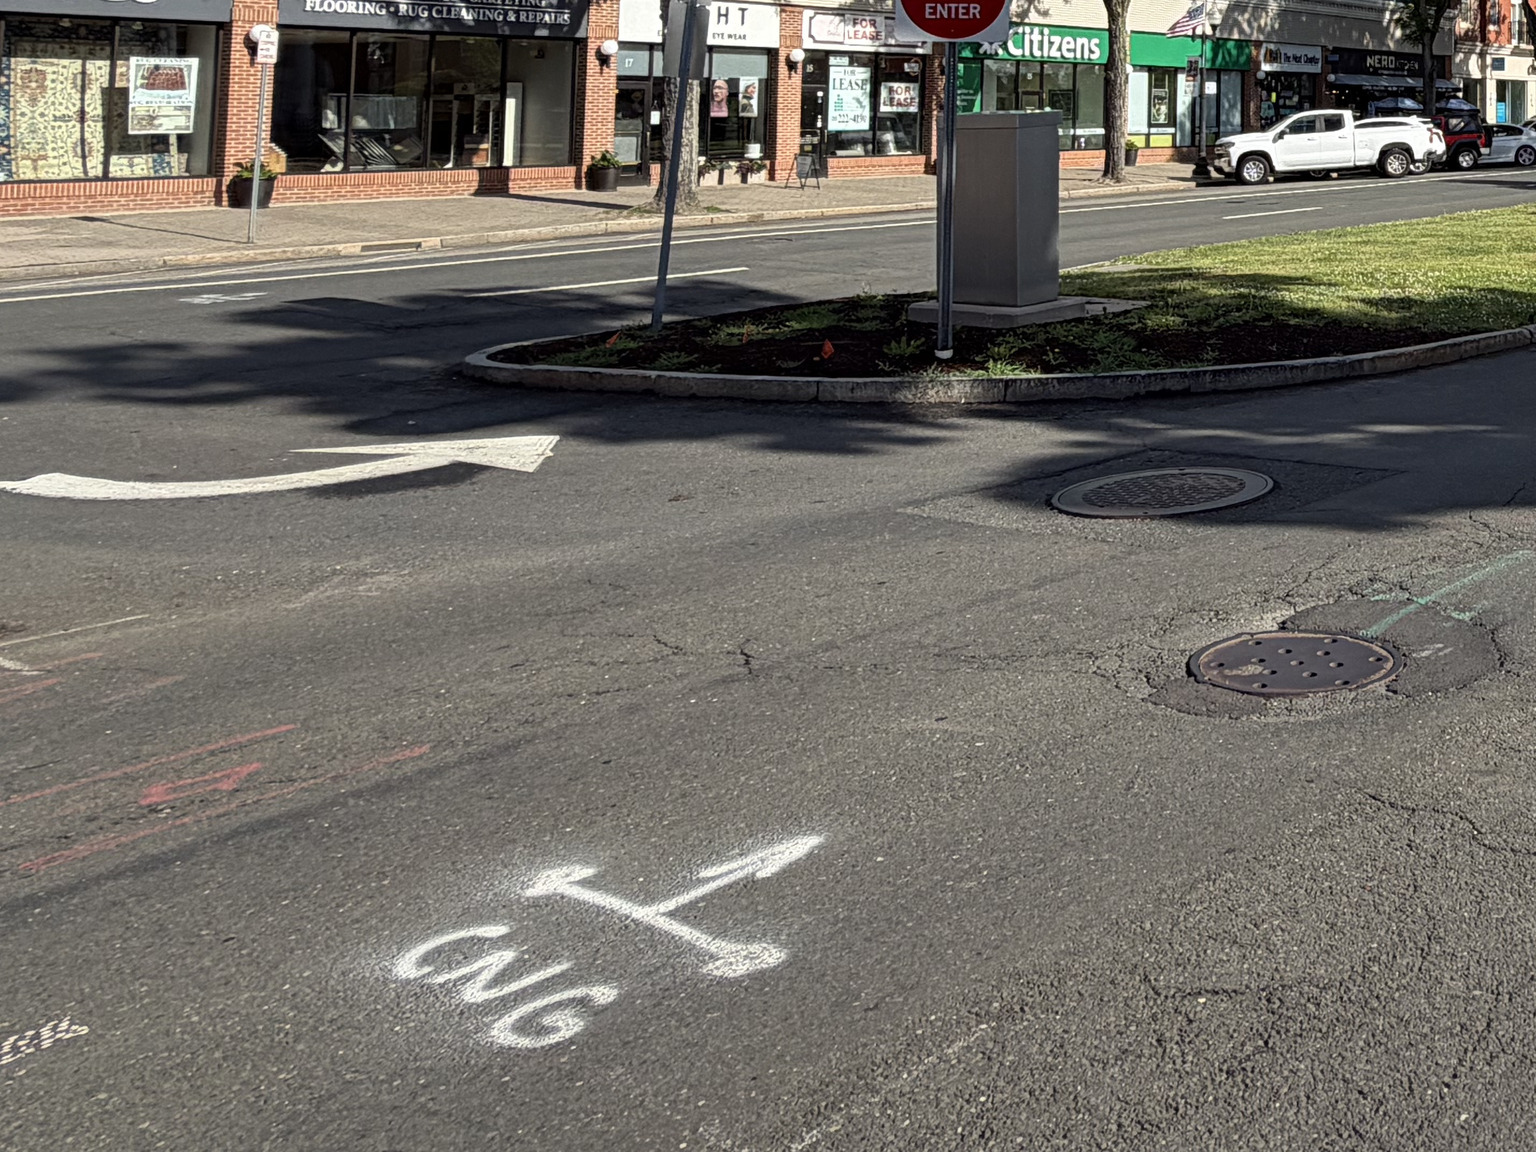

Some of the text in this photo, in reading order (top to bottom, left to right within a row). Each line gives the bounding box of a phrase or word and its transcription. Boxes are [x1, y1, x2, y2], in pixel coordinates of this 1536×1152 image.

[398, 3, 429, 17] RUG
[432, 5, 504, 21] CLEANING
[506, 10, 517, 22] &
[519, 11, 571, 25] REPAIRS
[925, 3, 981, 19] ENTER
[852, 18, 877, 30] FOR
[712, 32, 747, 41] EYE WEAR
[847, 29, 883, 41] LEASE
[1007, 26, 1101, 60] Citizens
[832, 78, 868, 91] LEASE
[888, 85, 912, 96] FOR
[882, 96, 917, 107] LEASE
[394, 923, 620, 1049] CNG
